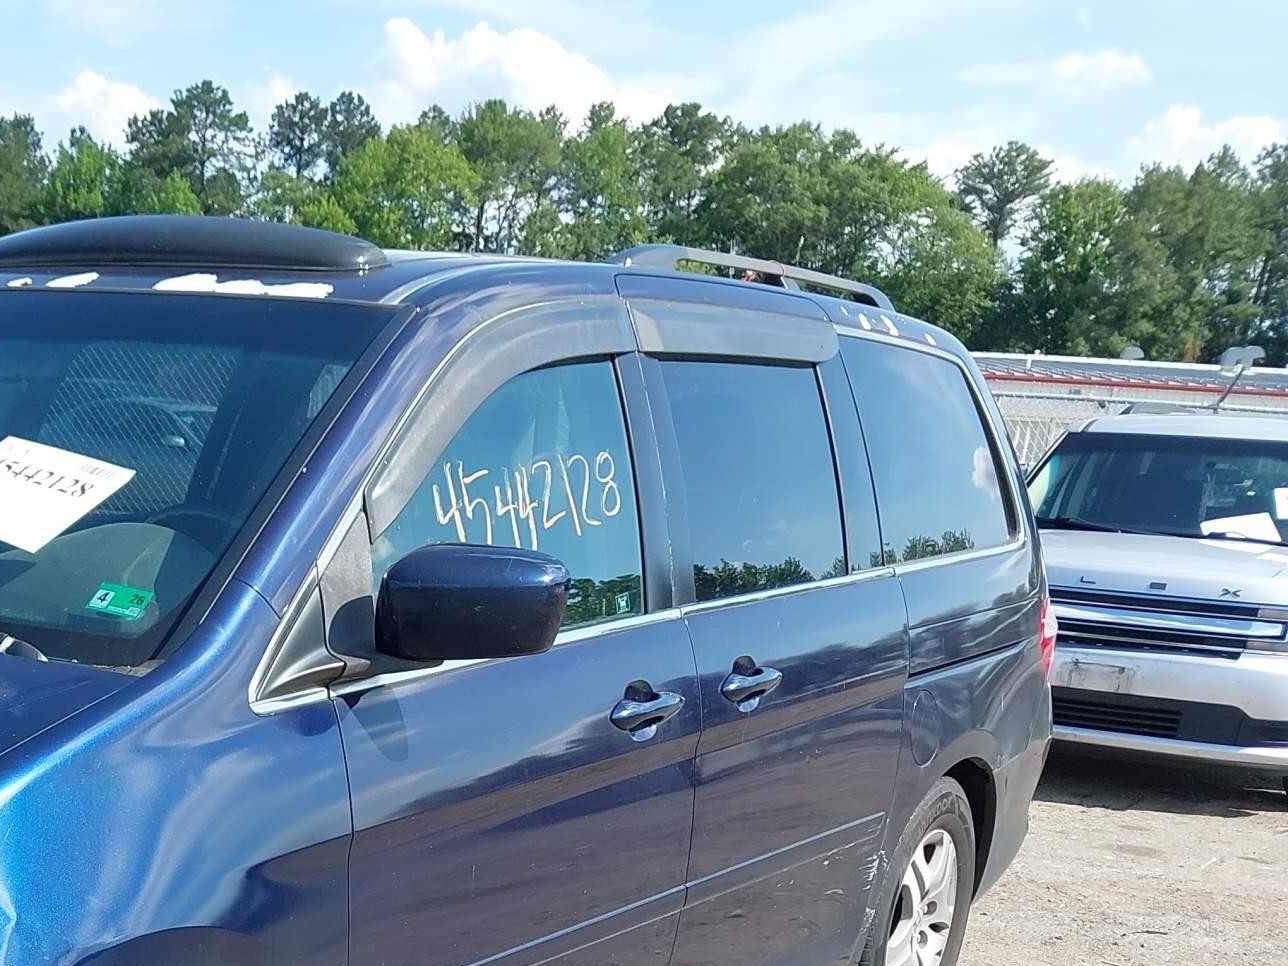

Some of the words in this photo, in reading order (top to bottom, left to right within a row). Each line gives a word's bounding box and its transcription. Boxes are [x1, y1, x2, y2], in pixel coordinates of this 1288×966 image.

[432, 451, 622, 550] 45442128
[97, 591, 111, 604] 4
[129, 593, 146, 606] 26
